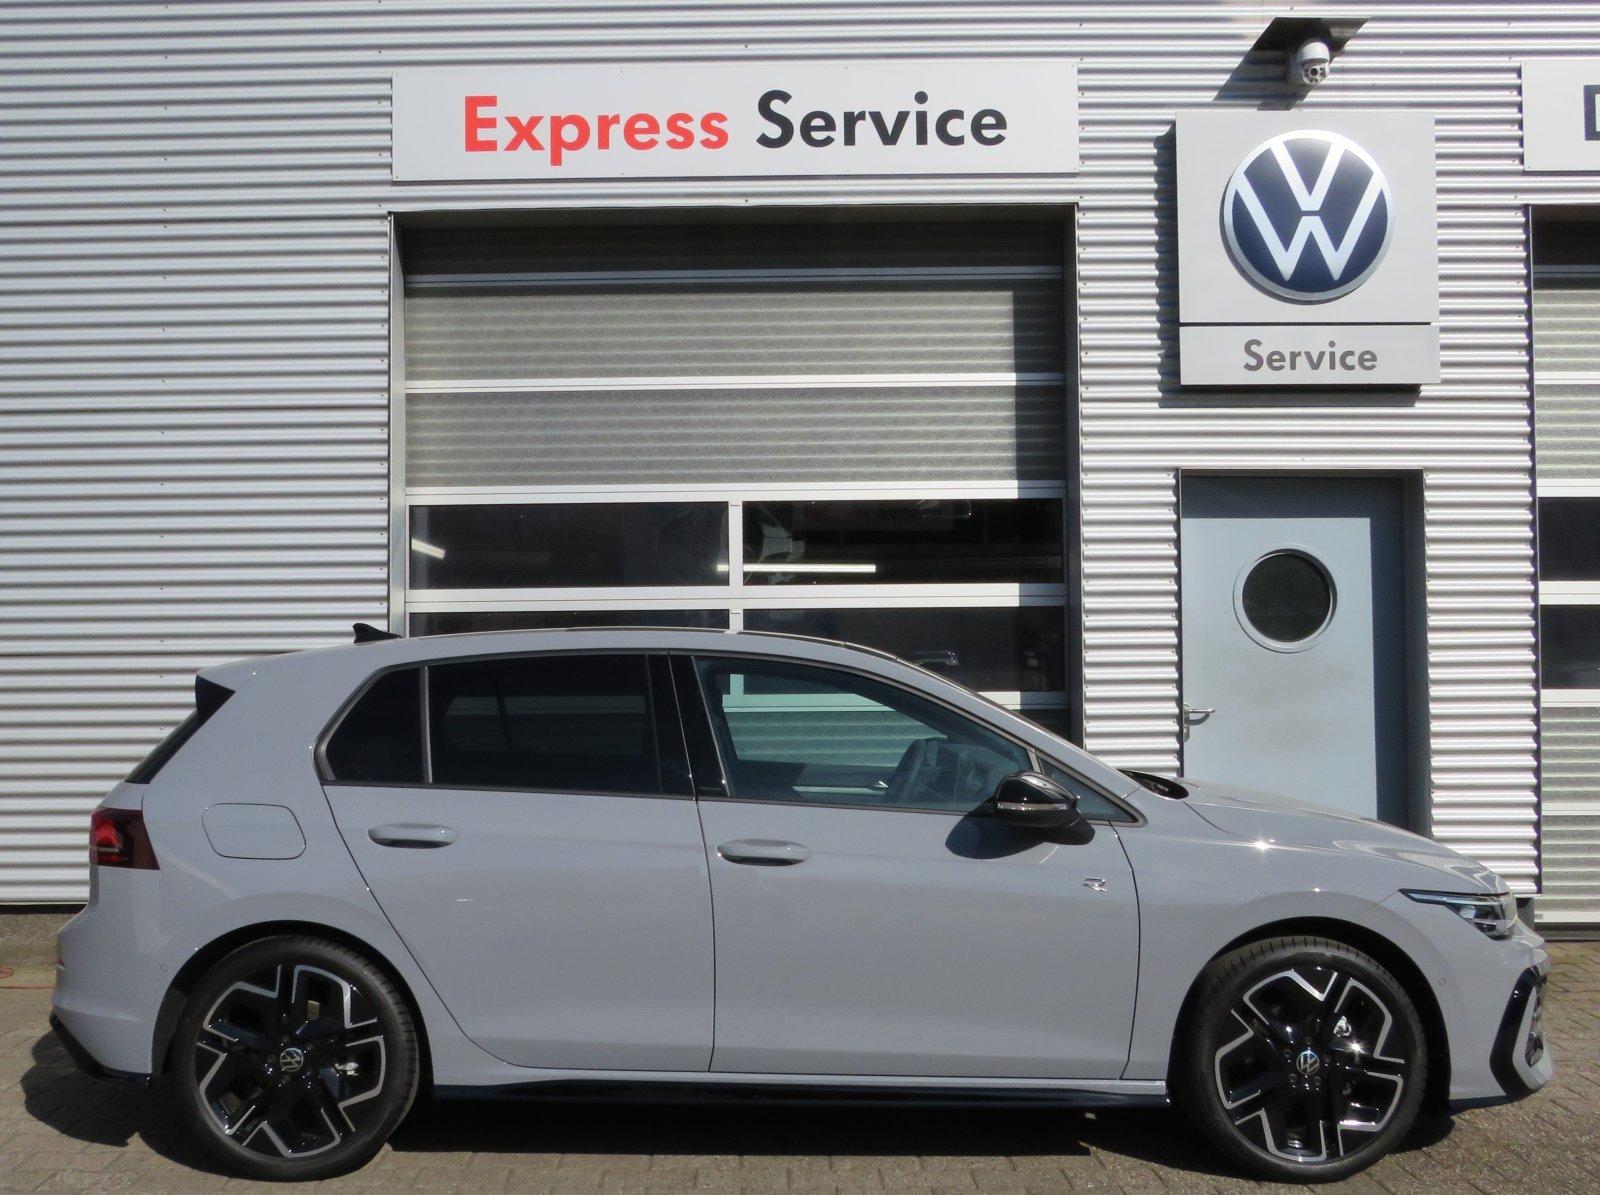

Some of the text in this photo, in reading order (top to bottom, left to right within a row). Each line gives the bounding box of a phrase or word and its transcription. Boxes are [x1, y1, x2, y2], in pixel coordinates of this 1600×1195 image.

[464, 89, 1008, 168] Express Service
[1229, 136, 1390, 287] VW
[1243, 338, 1378, 372] Service
